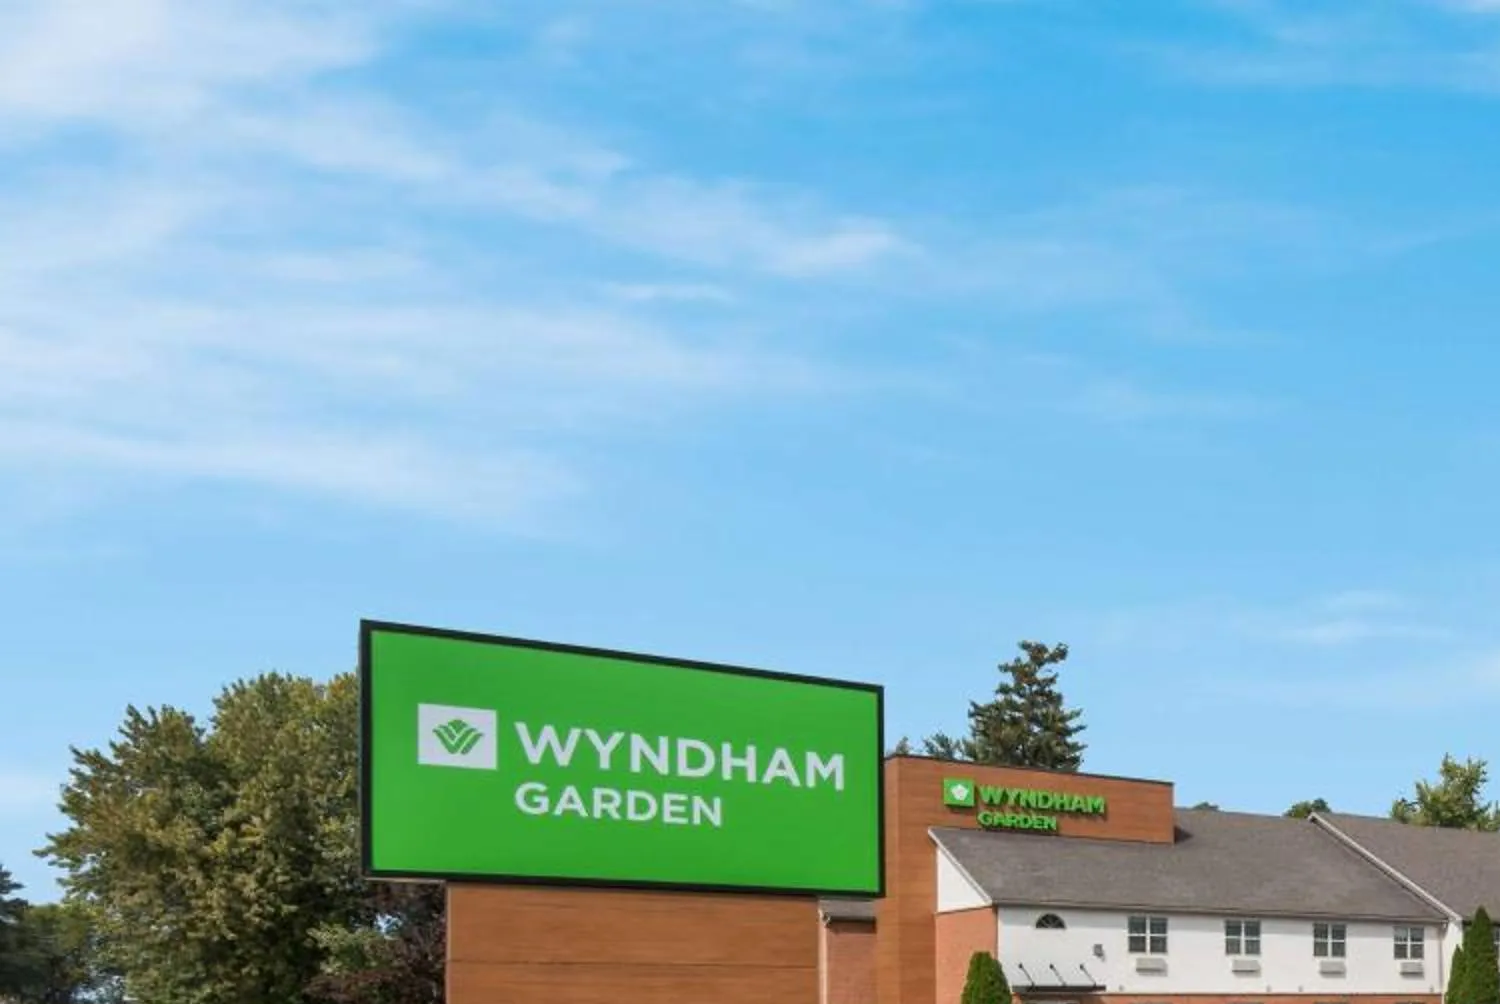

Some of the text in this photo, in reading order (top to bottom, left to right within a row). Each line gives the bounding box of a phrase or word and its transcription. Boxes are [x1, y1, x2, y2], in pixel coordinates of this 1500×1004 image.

[514, 721, 845, 791] WYNDHAM
[514, 781, 723, 827] GARDEN
[978, 784, 1106, 814] WYNDHAM
[977, 811, 1057, 830] GARDEN
